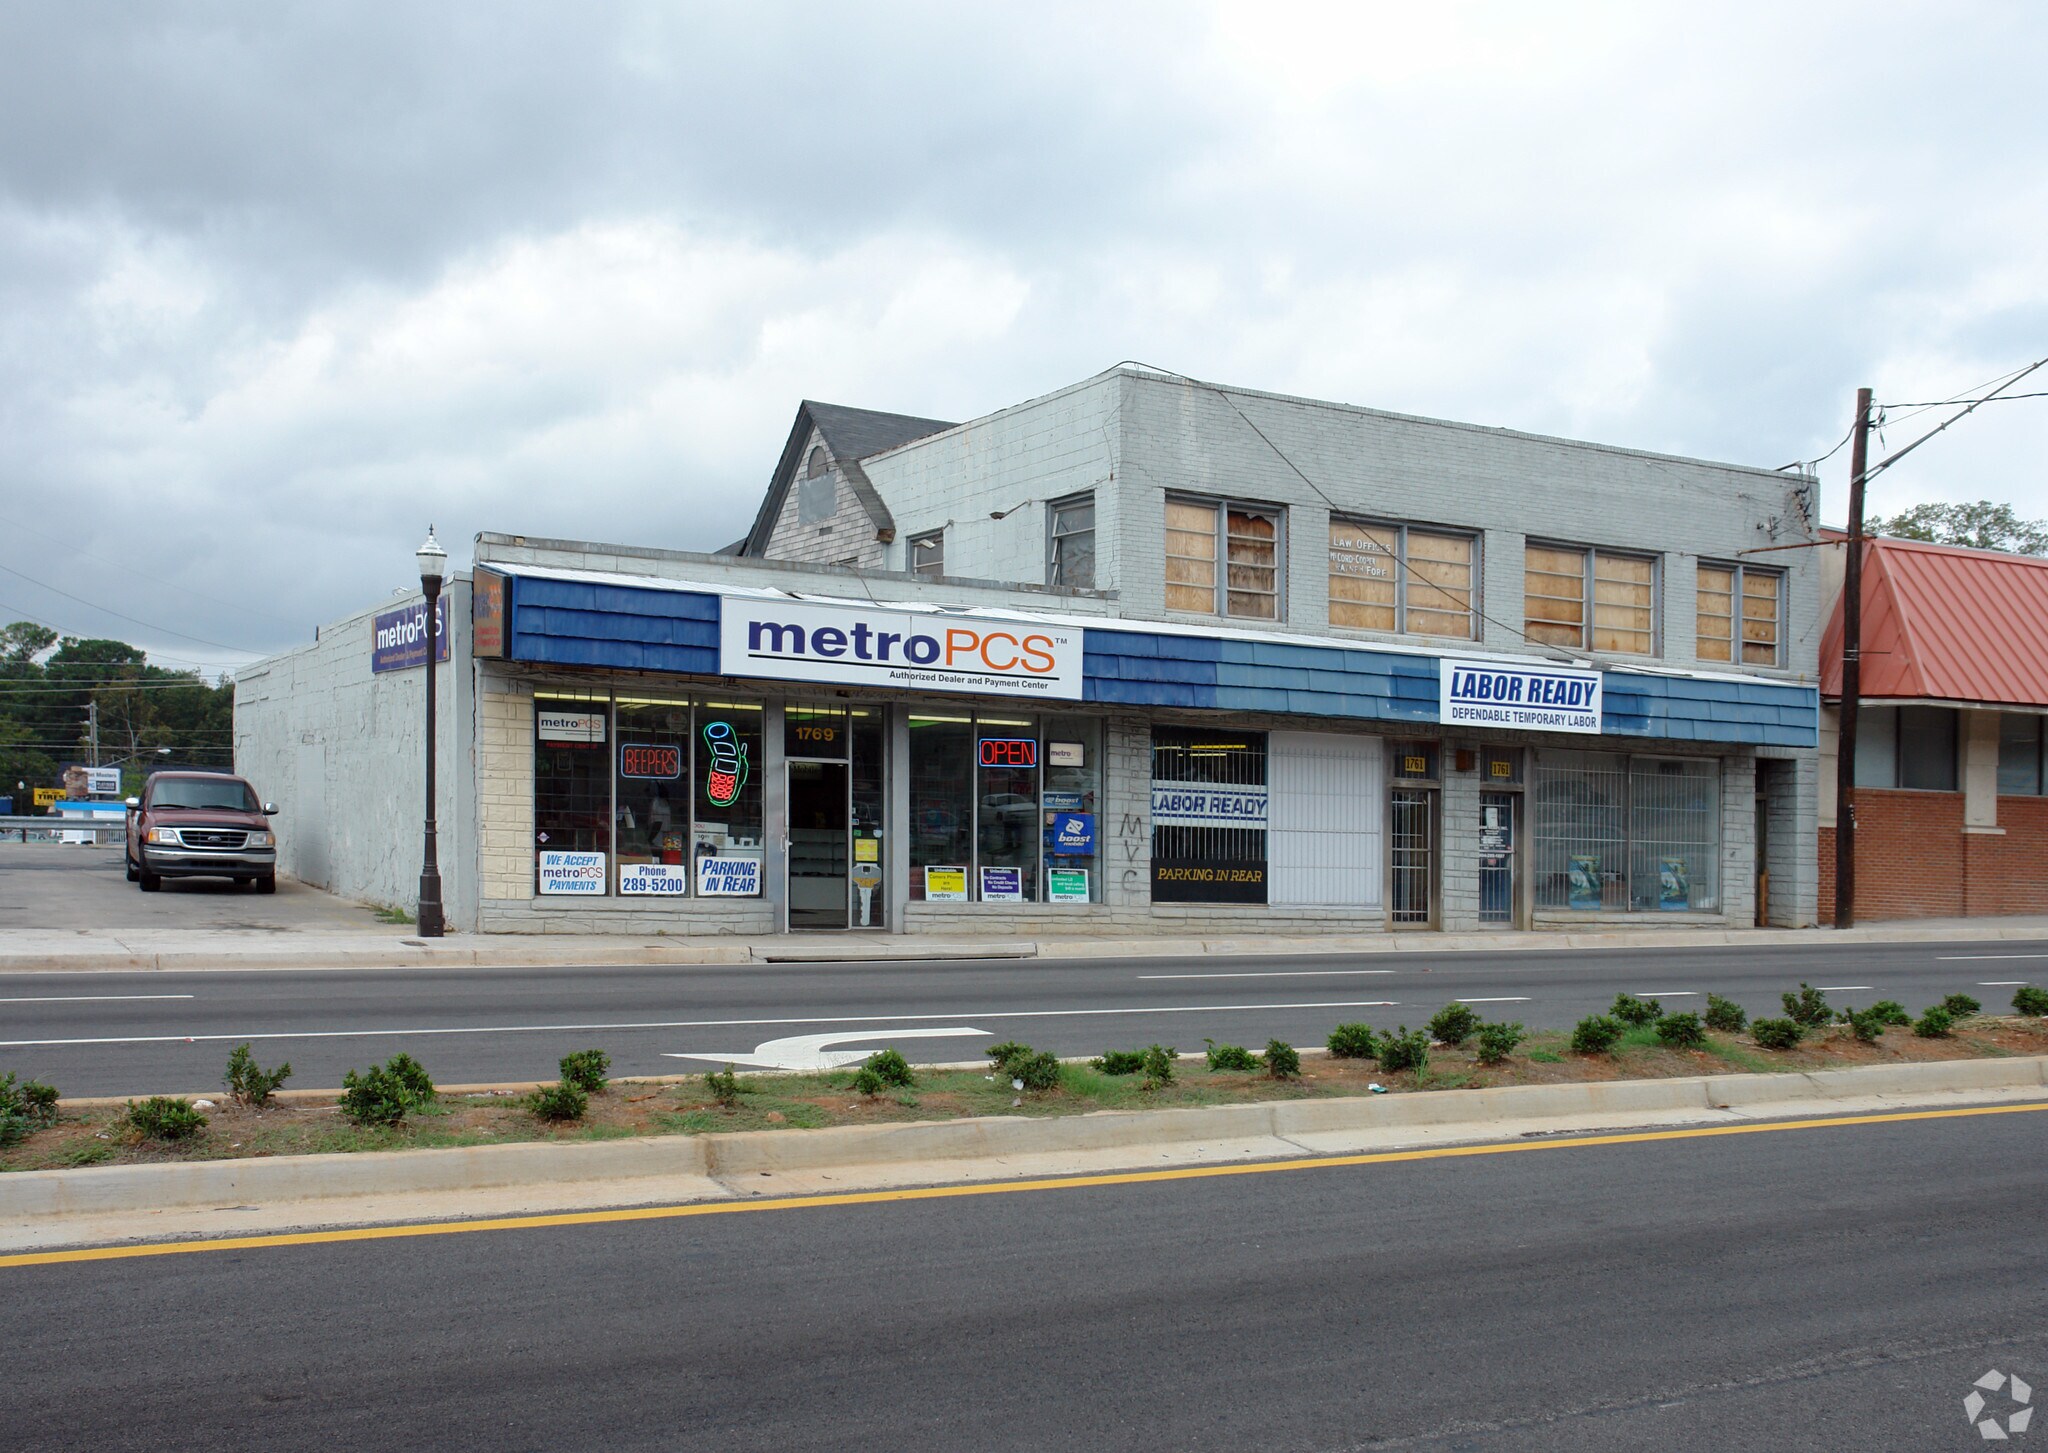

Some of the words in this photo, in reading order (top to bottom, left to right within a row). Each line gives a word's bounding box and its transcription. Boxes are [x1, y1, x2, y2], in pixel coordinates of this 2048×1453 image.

[748, 620, 1055, 674] metroPCS
[889, 670, 936, 682] Authorized
[938, 673, 966, 684] Dealer
[967, 675, 983, 685] and
[984, 677, 1020, 689] Payment
[1021, 679, 1049, 690] Center
[1450, 671, 1523, 701] LABOR
[1527, 678, 1598, 707] READY
[541, 717, 601, 730] metroPCS
[1452, 707, 1511, 722] DEPENDABLE
[1513, 711, 1567, 726] TEMPORARY
[1568, 715, 1597, 728] LABOR
[795, 727, 834, 742] 1769
[981, 741, 1035, 765] OPEN
[625, 748, 678, 775] BEEPERS
[1152, 794, 1206, 813] LABOR
[1209, 797, 1268, 815] READY
[1058, 832, 1091, 843] boost
[546, 854, 561, 865] WE
[563, 854, 599, 866] ACCEPT
[701, 859, 757, 876] PARKING
[543, 867, 603, 878] metroPCS
[639, 865, 667, 876] Phone
[1157, 867, 1214, 881] PARKING
[1215, 869, 1229, 881] IN
[1230, 870, 1263, 882] REAR
[548, 879, 597, 891] PAYMENTS
[623, 877, 683, 892] 289-5200
[705, 877, 720, 891] IN
[722, 876, 756, 892] REAR
